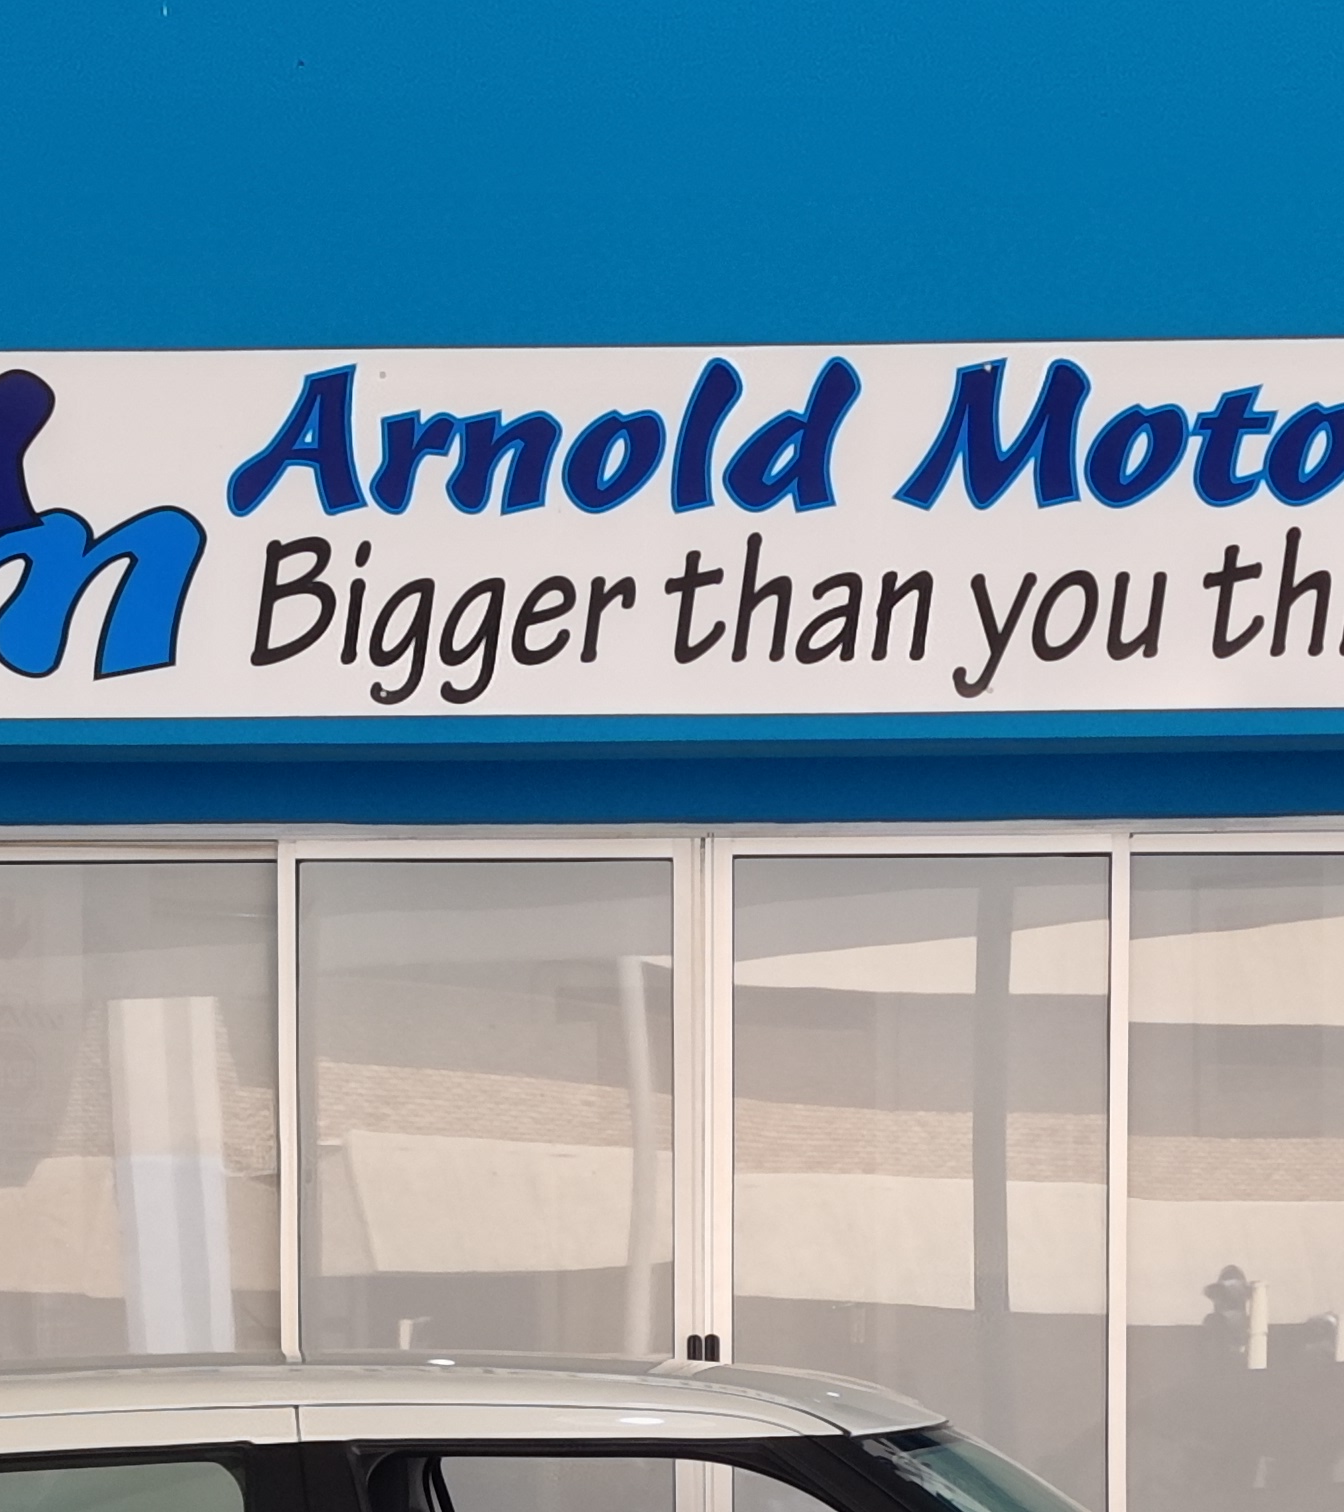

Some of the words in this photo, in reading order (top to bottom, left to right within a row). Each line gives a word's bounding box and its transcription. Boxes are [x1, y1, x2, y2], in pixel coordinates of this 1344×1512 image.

[226, 362, 862, 516] Arnold
[250, 536, 636, 705] Bigger
[664, 532, 934, 665] than
[952, 569, 1168, 699] you
